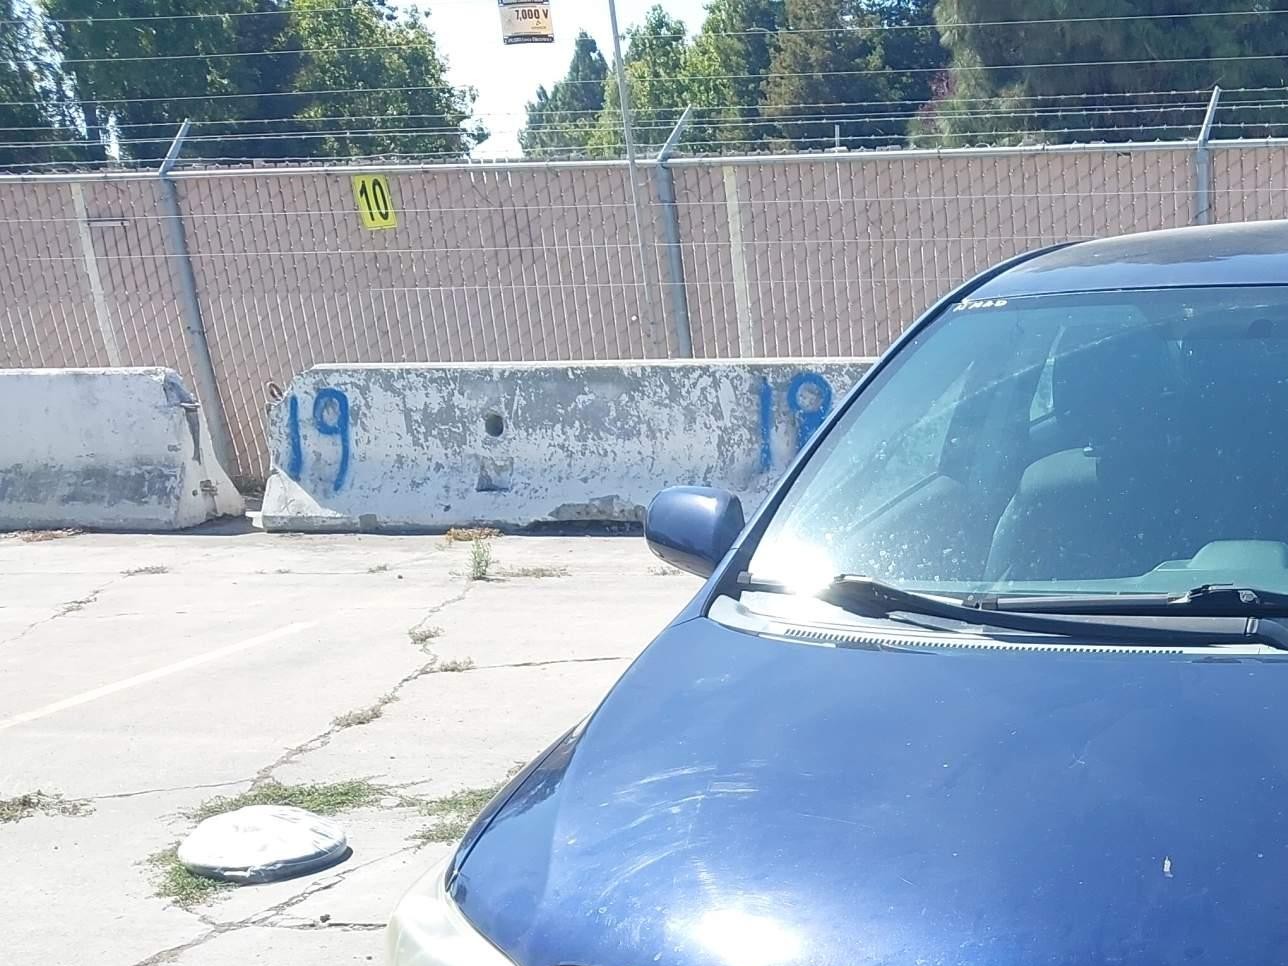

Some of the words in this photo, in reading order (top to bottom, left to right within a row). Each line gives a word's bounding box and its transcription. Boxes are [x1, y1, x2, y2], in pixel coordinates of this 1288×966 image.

[514, 8, 541, 21] 7,000
[542, 8, 549, 19] V
[360, 178, 389, 221] 10
[288, 387, 350, 492] 19
